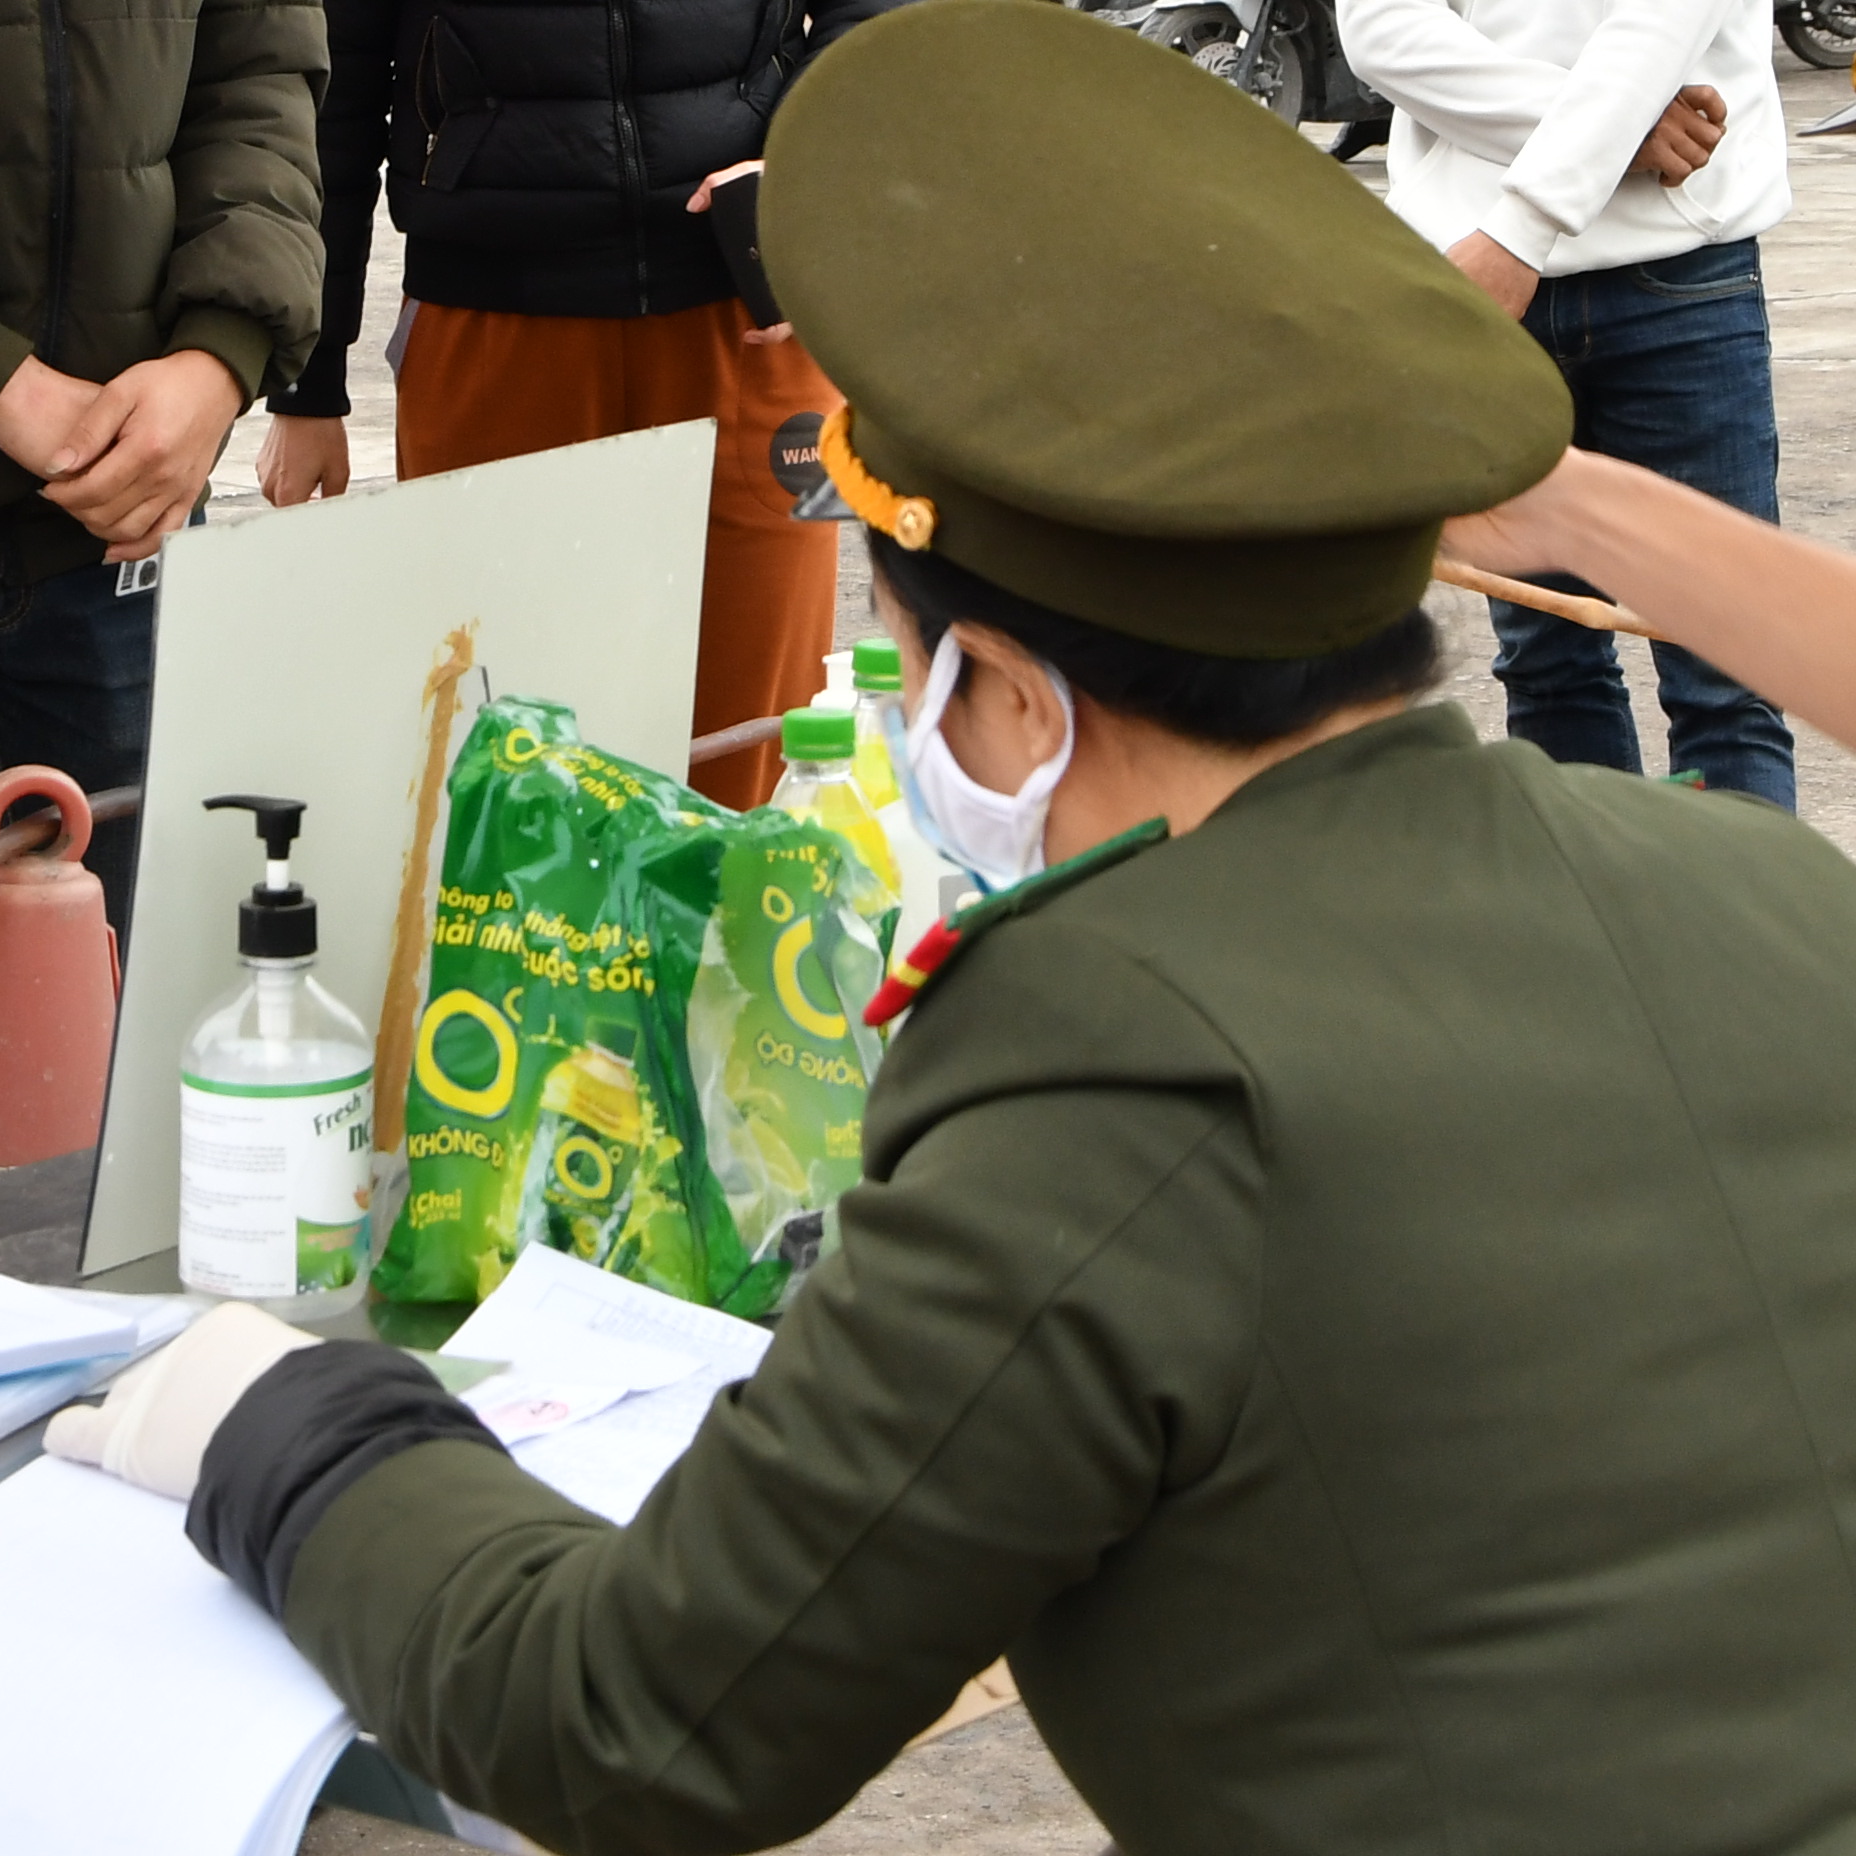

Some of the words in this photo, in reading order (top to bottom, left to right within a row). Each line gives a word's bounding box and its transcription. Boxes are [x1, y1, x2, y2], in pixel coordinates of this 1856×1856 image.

[495, 889, 514, 909] lo
[433, 913, 477, 946] iải
[313, 1092, 362, 1137] Fresh
[408, 1124, 491, 1160] KHÔNG
